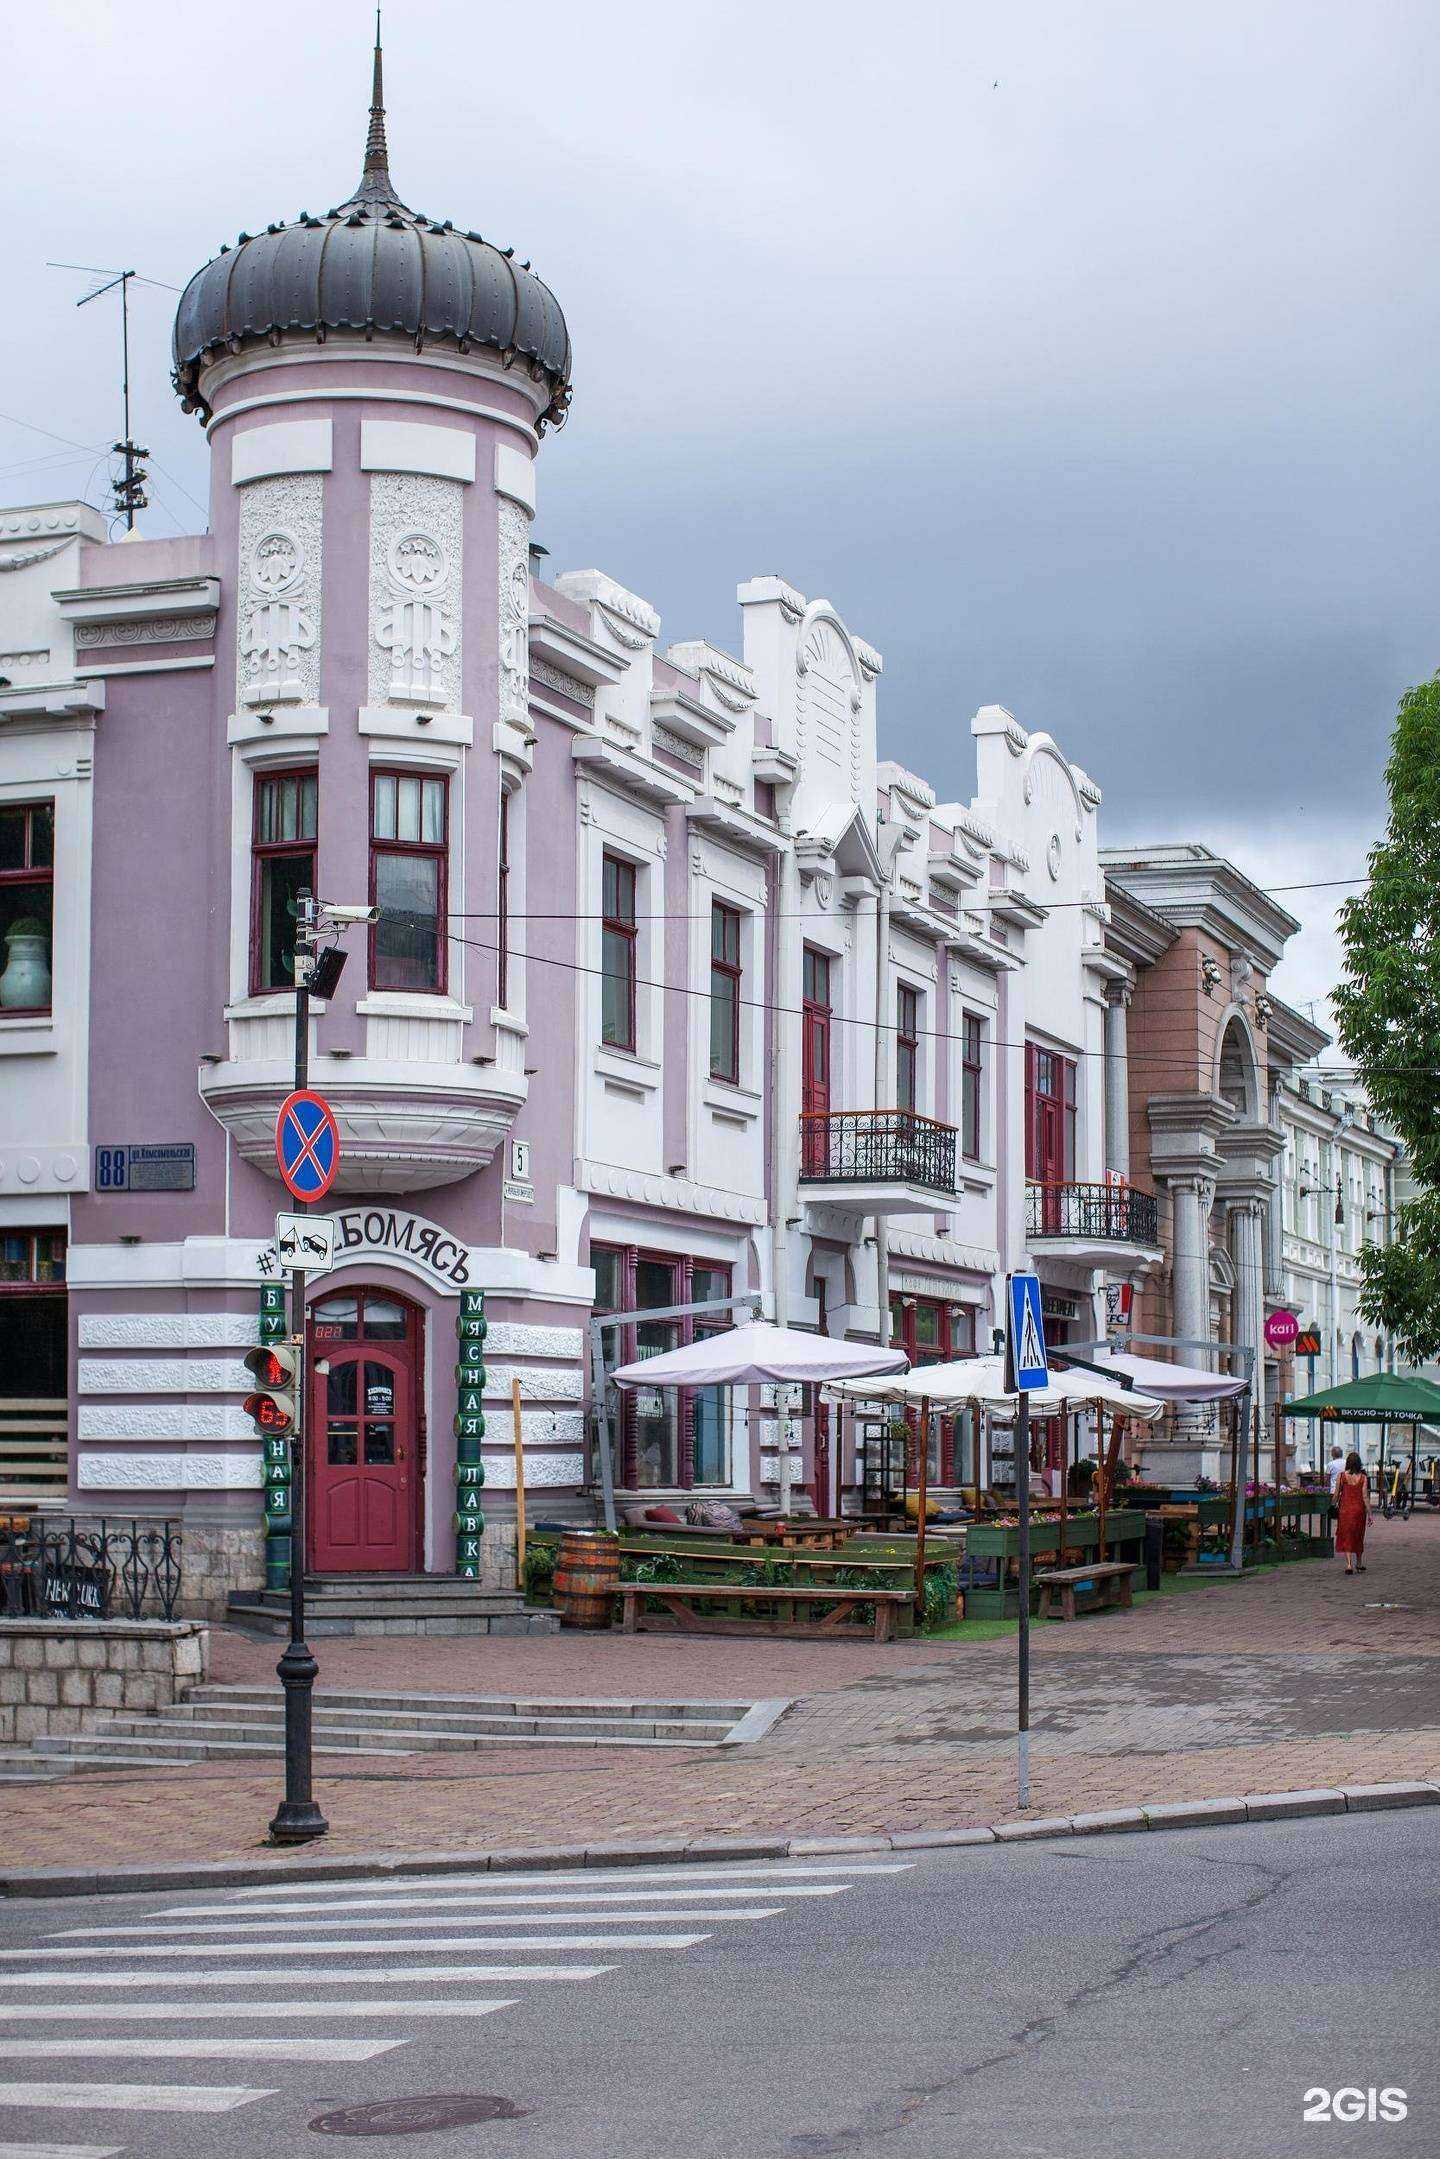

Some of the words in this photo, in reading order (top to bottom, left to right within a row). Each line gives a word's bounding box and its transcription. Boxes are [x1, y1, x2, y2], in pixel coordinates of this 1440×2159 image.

[100, 1150, 125, 1186] 88
[517, 1146, 523, 1172] 5
[256, 1212, 470, 1285] #БОМЯСЪ
[1106, 1313, 1125, 1323] FC
[1269, 1323, 1295, 1335] kari
[466, 1295, 483, 1435] МЯСНАЯ
[1341, 1409, 1377, 1417] ВКУСНО
[1394, 1410, 1424, 1420] ТОЧКА
